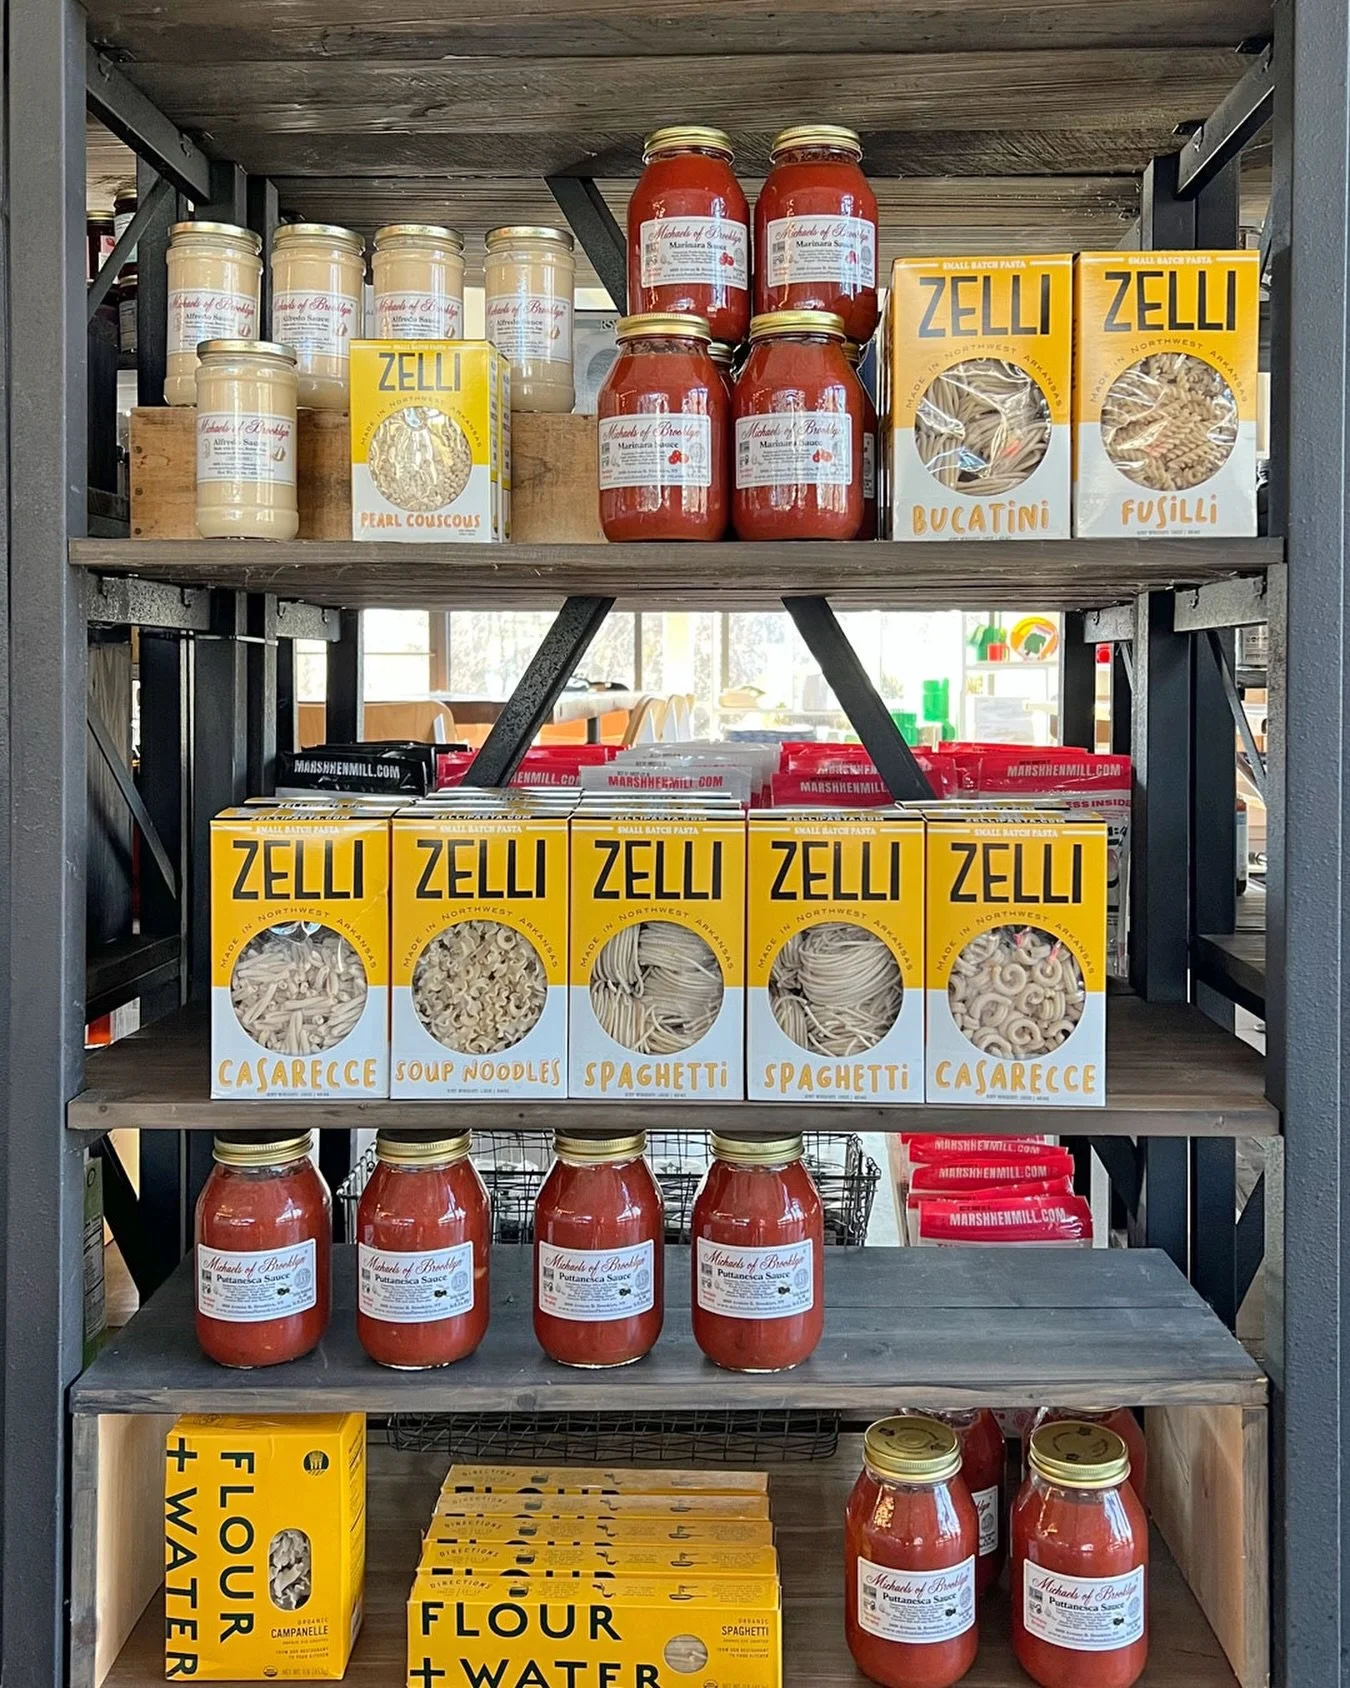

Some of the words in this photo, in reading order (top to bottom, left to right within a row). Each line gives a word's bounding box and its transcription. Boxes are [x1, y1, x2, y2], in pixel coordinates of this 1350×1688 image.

[693, 226, 705, 241] of
[796, 240, 832, 248] Marinara
[820, 224, 831, 240] of
[669, 241, 705, 249] Marinara
[943, 262, 969, 270] SMALL
[1000, 260, 1026, 268] PASTA
[1128, 257, 1154, 265] SMALL
[1186, 256, 1213, 264] PASTA
[918, 274, 1050, 338] ZELLI
[1104, 270, 1236, 332] ZELLI
[378, 352, 461, 391] ZELLI
[945, 343, 1017, 360] NORTHWEST
[1023, 353, 1062, 408] ARKANSAS
[1130, 338, 1204, 354] NORTHWEST
[1209, 349, 1248, 403] ARKANSAS
[360, 421, 375, 446] MADE
[640, 424, 652, 442] of
[618, 441, 653, 450] Marinara
[360, 511, 401, 530] PEARL
[406, 511, 481, 529] COUSCOUS
[912, 499, 1050, 536] BUCATINI
[1121, 494, 1218, 526] FUSILLI
[294, 759, 400, 779] MARSHHENMILL.COM
[1007, 763, 1121, 777] MARSHHENMILL.COM
[617, 826, 643, 835] SMALL
[645, 826, 673, 835] BATCH
[673, 827, 699, 835] PASTA
[794, 827, 821, 835] SMALL
[822, 827, 849, 835] BATCH
[850, 828, 877, 836] PASTA
[974, 829, 1000, 837] SMALL
[231, 839, 365, 900] ZELLI
[415, 839, 547, 900] ZELLI
[592, 839, 723, 900] ZELLI
[769, 840, 901, 901] ZELLI
[950, 842, 1083, 904] ZELLI
[220, 939, 239, 970] MADE
[241, 923, 253, 935] IN
[257, 906, 331, 923] NORTHWEST
[336, 917, 378, 970] ARKANSAS
[403, 938, 423, 969] MADE
[425, 921, 437, 934] IN
[441, 905, 514, 921] NORTHWEST
[519, 916, 559, 969] ARKANSAS
[579, 938, 600, 969] MADE
[602, 922, 614, 934] IN
[618, 905, 690, 921] NORTHWEST
[694, 918, 734, 970] ARKANSAS
[757, 936, 777, 969] MADE
[779, 924, 791, 935] IN
[796, 907, 868, 923] NORTHWEST
[873, 919, 914, 972] ARKANSAS
[936, 940, 956, 972] MADE
[959, 926, 971, 937] IN
[975, 910, 1049, 924] NORTHWEST
[1054, 922, 1096, 976] ARKANSAS
[218, 1057, 378, 1094] CASARECCE
[394, 1059, 456, 1083] SOUP
[462, 1058, 562, 1084] NOODLES
[584, 1061, 729, 1093] SPAGHETTI
[764, 1063, 909, 1094] SPAGHETTI
[935, 1059, 1097, 1096] CASARECCE
[934, 1139, 1041, 1155] MARSHHENMILL.COM
[939, 1165, 1047, 1180] MARSHHENMILL.COM
[950, 1208, 1066, 1227] MARSHHENMILL.COM
[203, 1255, 242, 1274] Michaels
[244, 1261, 257, 1278] of
[257, 1254, 306, 1274] Brooklyn
[363, 1255, 401, 1274] Michaels
[402, 1262, 414, 1278] of
[415, 1256, 462, 1275] Brooklyn
[545, 1253, 587, 1272] Michaels
[588, 1260, 600, 1277] of
[601, 1254, 645, 1273] Brooklyn
[703, 1249, 744, 1269] Michaels
[747, 1257, 759, 1273] of
[760, 1252, 804, 1271] Brooklyn
[216, 1274, 262, 1284] Puttanesca
[264, 1272, 291, 1283] Sauce
[374, 1274, 420, 1285] Puttanesca
[421, 1274, 448, 1284] Sauce
[559, 1272, 605, 1283] Puttanesca
[606, 1272, 632, 1281] Sauce
[717, 1268, 764, 1280] Puttanesca
[765, 1271, 790, 1280] Sauce
[219, 1452, 255, 1643] FLOUR
[439, 1547, 500, 1558] DIRECTIONS
[165, 1486, 198, 1678] WATER
[430, 1579, 495, 1589] DIRECTIONS
[865, 1573, 912, 1594] Michaels
[915, 1581, 927, 1598] of
[928, 1572, 969, 1594] Brooklyn
[1032, 1576, 1079, 1600] Michaels
[1081, 1588, 1094, 1606] of
[1095, 1582, 1137, 1602] Brooklyn
[883, 1592, 931, 1605] Puttanesca
[933, 1593, 957, 1603] Sauce
[1048, 1596, 1099, 1612] Puttanesca
[1100, 1602, 1125, 1611] Sauce
[271, 1625, 329, 1639] CAMPANELLE
[421, 1601, 623, 1641] FLOUR
[721, 1625, 769, 1637] SPAGHETTI
[459, 1658, 661, 1688] WATER
